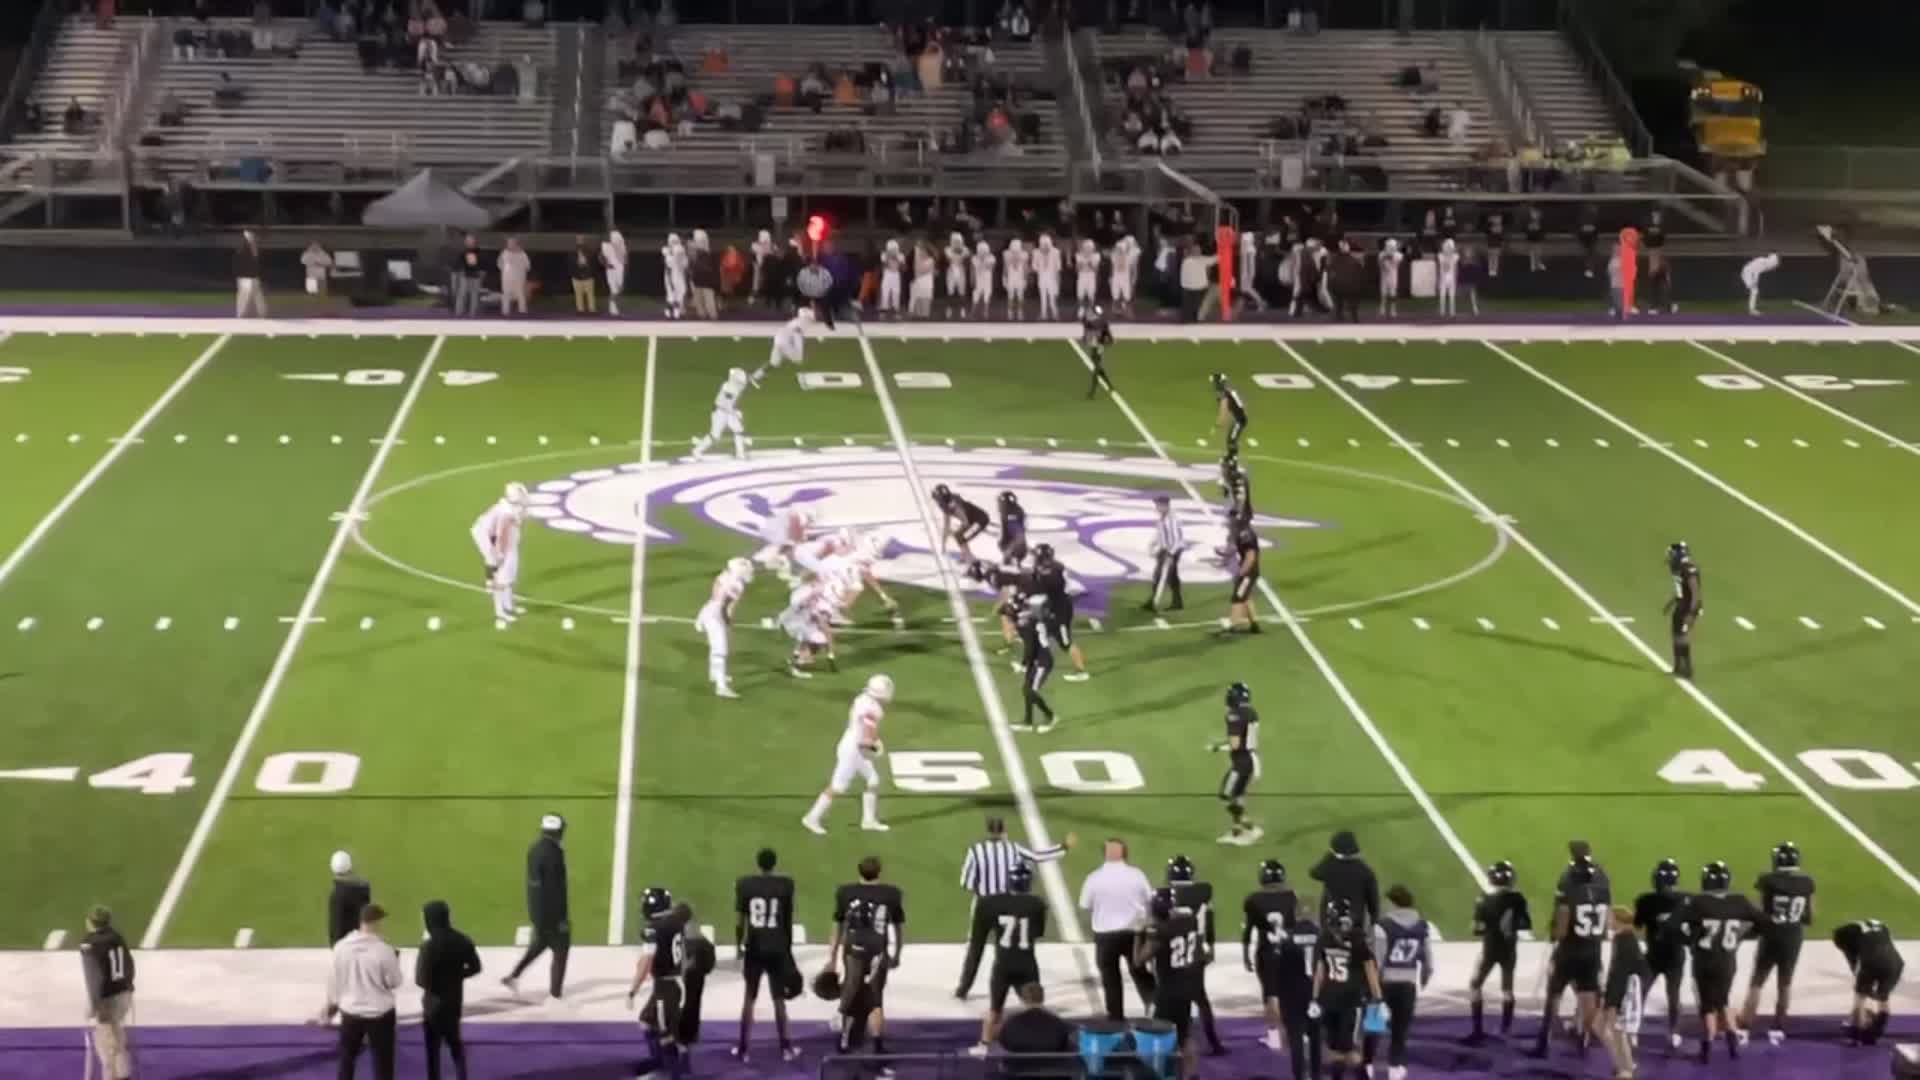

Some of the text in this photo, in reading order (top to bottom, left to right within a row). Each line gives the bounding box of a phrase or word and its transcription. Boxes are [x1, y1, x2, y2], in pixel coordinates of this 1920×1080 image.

[88, 751, 361, 795] 40
[889, 751, 1144, 792] 50
[1656, 749, 1920, 789] 40
[749, 897, 779, 928] 81
[998, 914, 1029, 950] 71
[1699, 919, 1741, 950] 76
[1389, 938, 1419, 962] 67
[1326, 955, 1350, 982] 15
